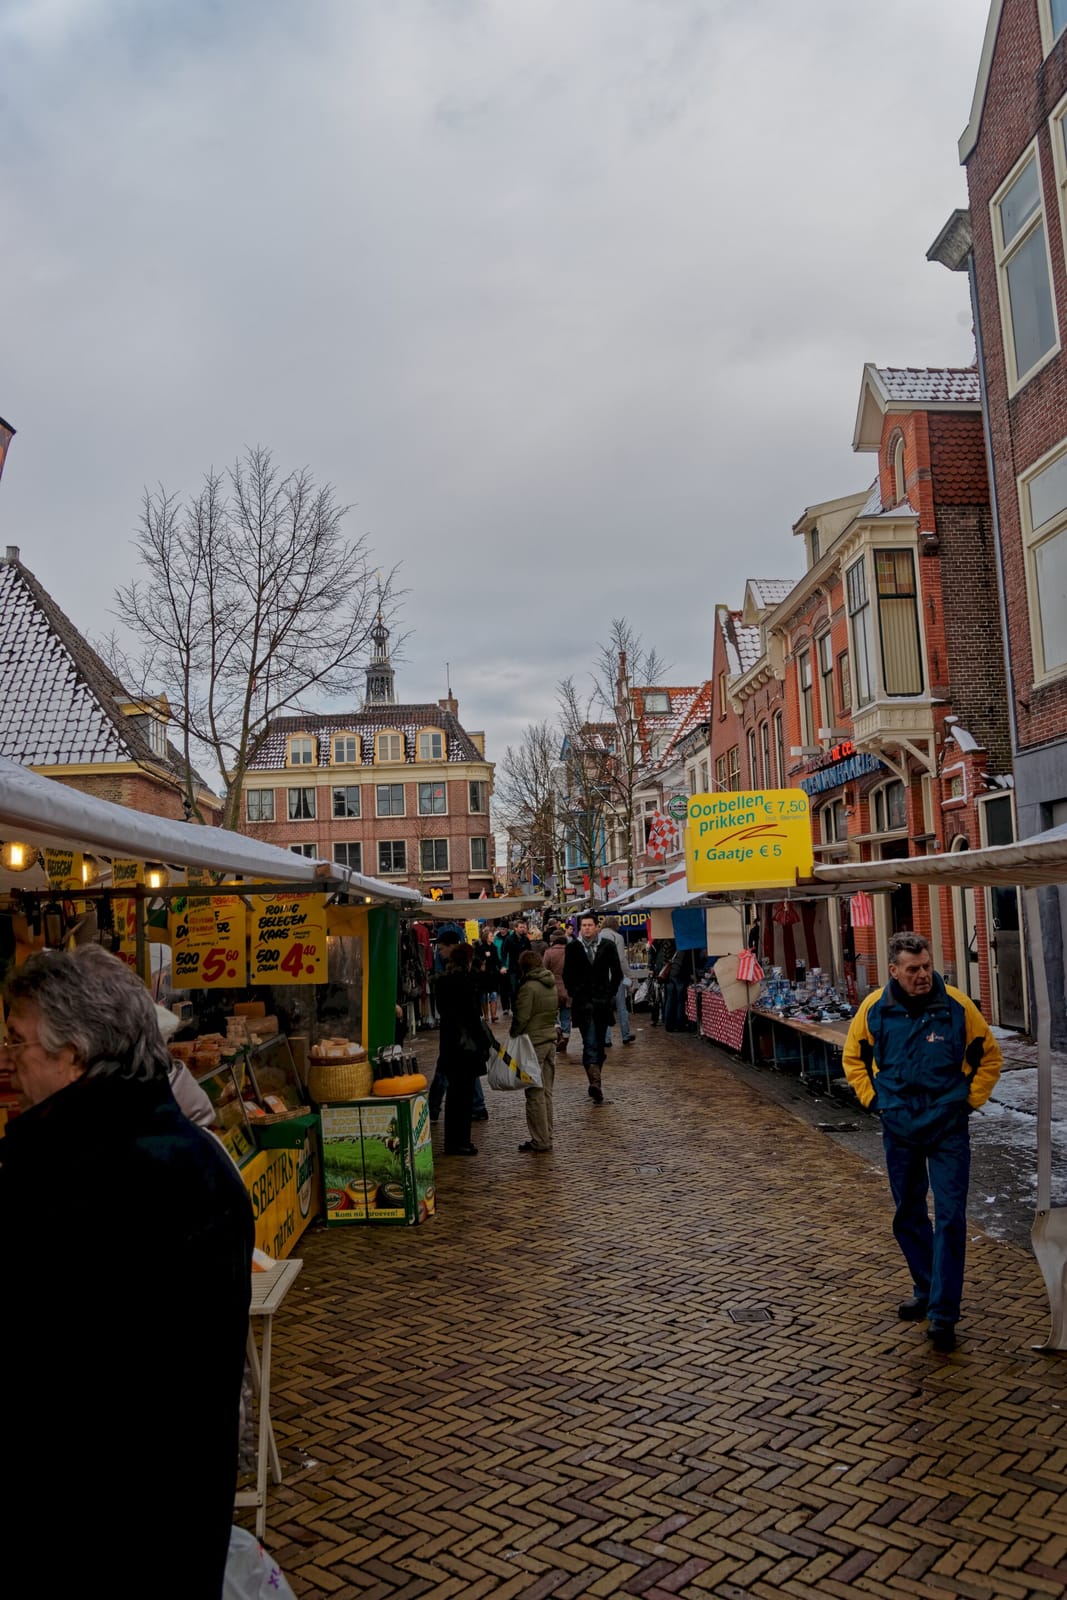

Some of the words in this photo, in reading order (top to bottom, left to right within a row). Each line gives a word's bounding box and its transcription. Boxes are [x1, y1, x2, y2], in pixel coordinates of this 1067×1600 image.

[690, 795, 764, 818] Oorbellen
[777, 800, 807, 814] 7,50
[699, 812, 755, 837] prikken
[694, 849, 699, 861] 1
[706, 847, 754, 862] Gaatje
[773, 844, 782, 857] 5
[258, 914, 307, 929] BELEGEN
[258, 928, 291, 944] KAAS
[175, 952, 200, 965] 500
[255, 949, 280, 963] 500
